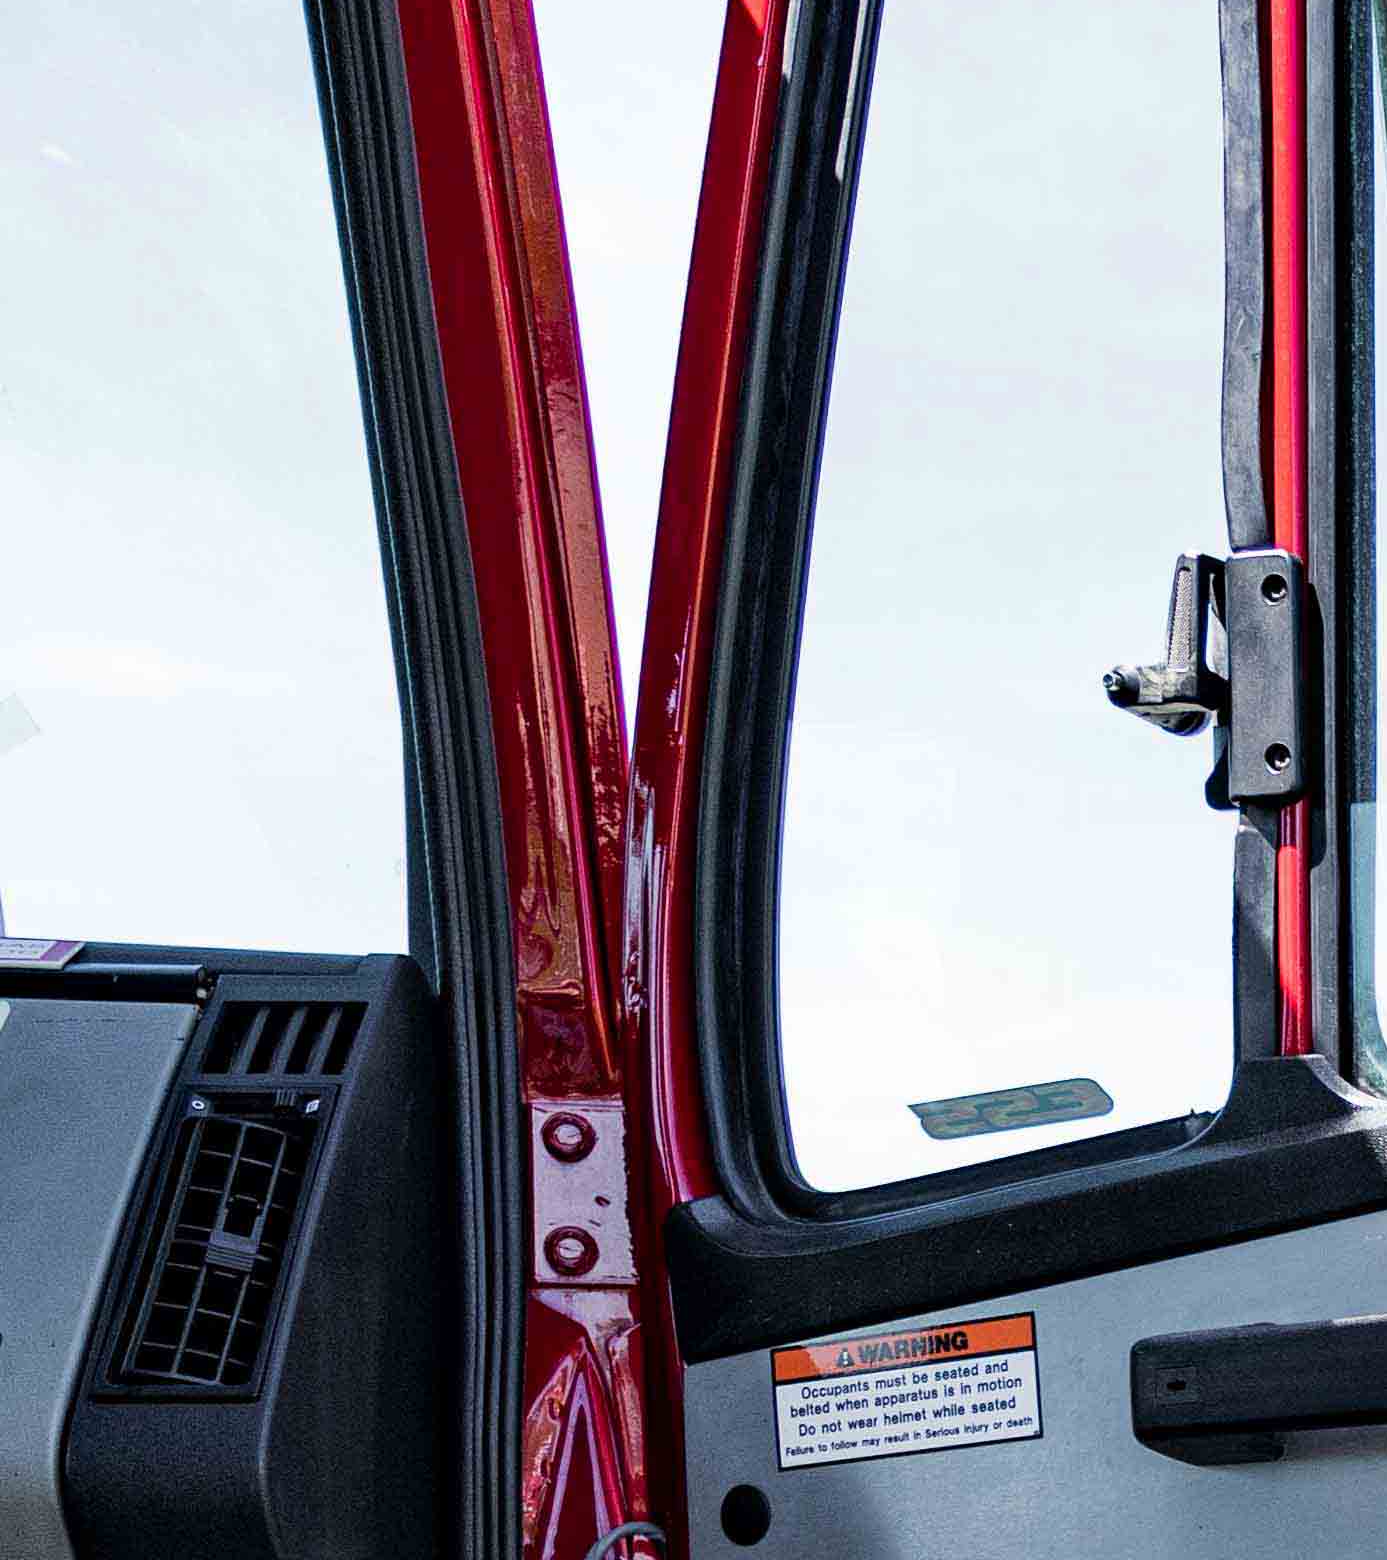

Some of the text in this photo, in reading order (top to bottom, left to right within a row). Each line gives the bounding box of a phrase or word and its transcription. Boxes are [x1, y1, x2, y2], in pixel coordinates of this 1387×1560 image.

[858, 1332, 968, 1364] WARNING
[790, 1377, 1022, 1418] belted when apparatus is in motion
[801, 1360, 1008, 1399] Occupants must be seated and
[786, 1416, 1033, 1456] Failure to follow may result in Serious injury or death
[799, 1398, 1016, 1436] Do not wear helmet while seated
